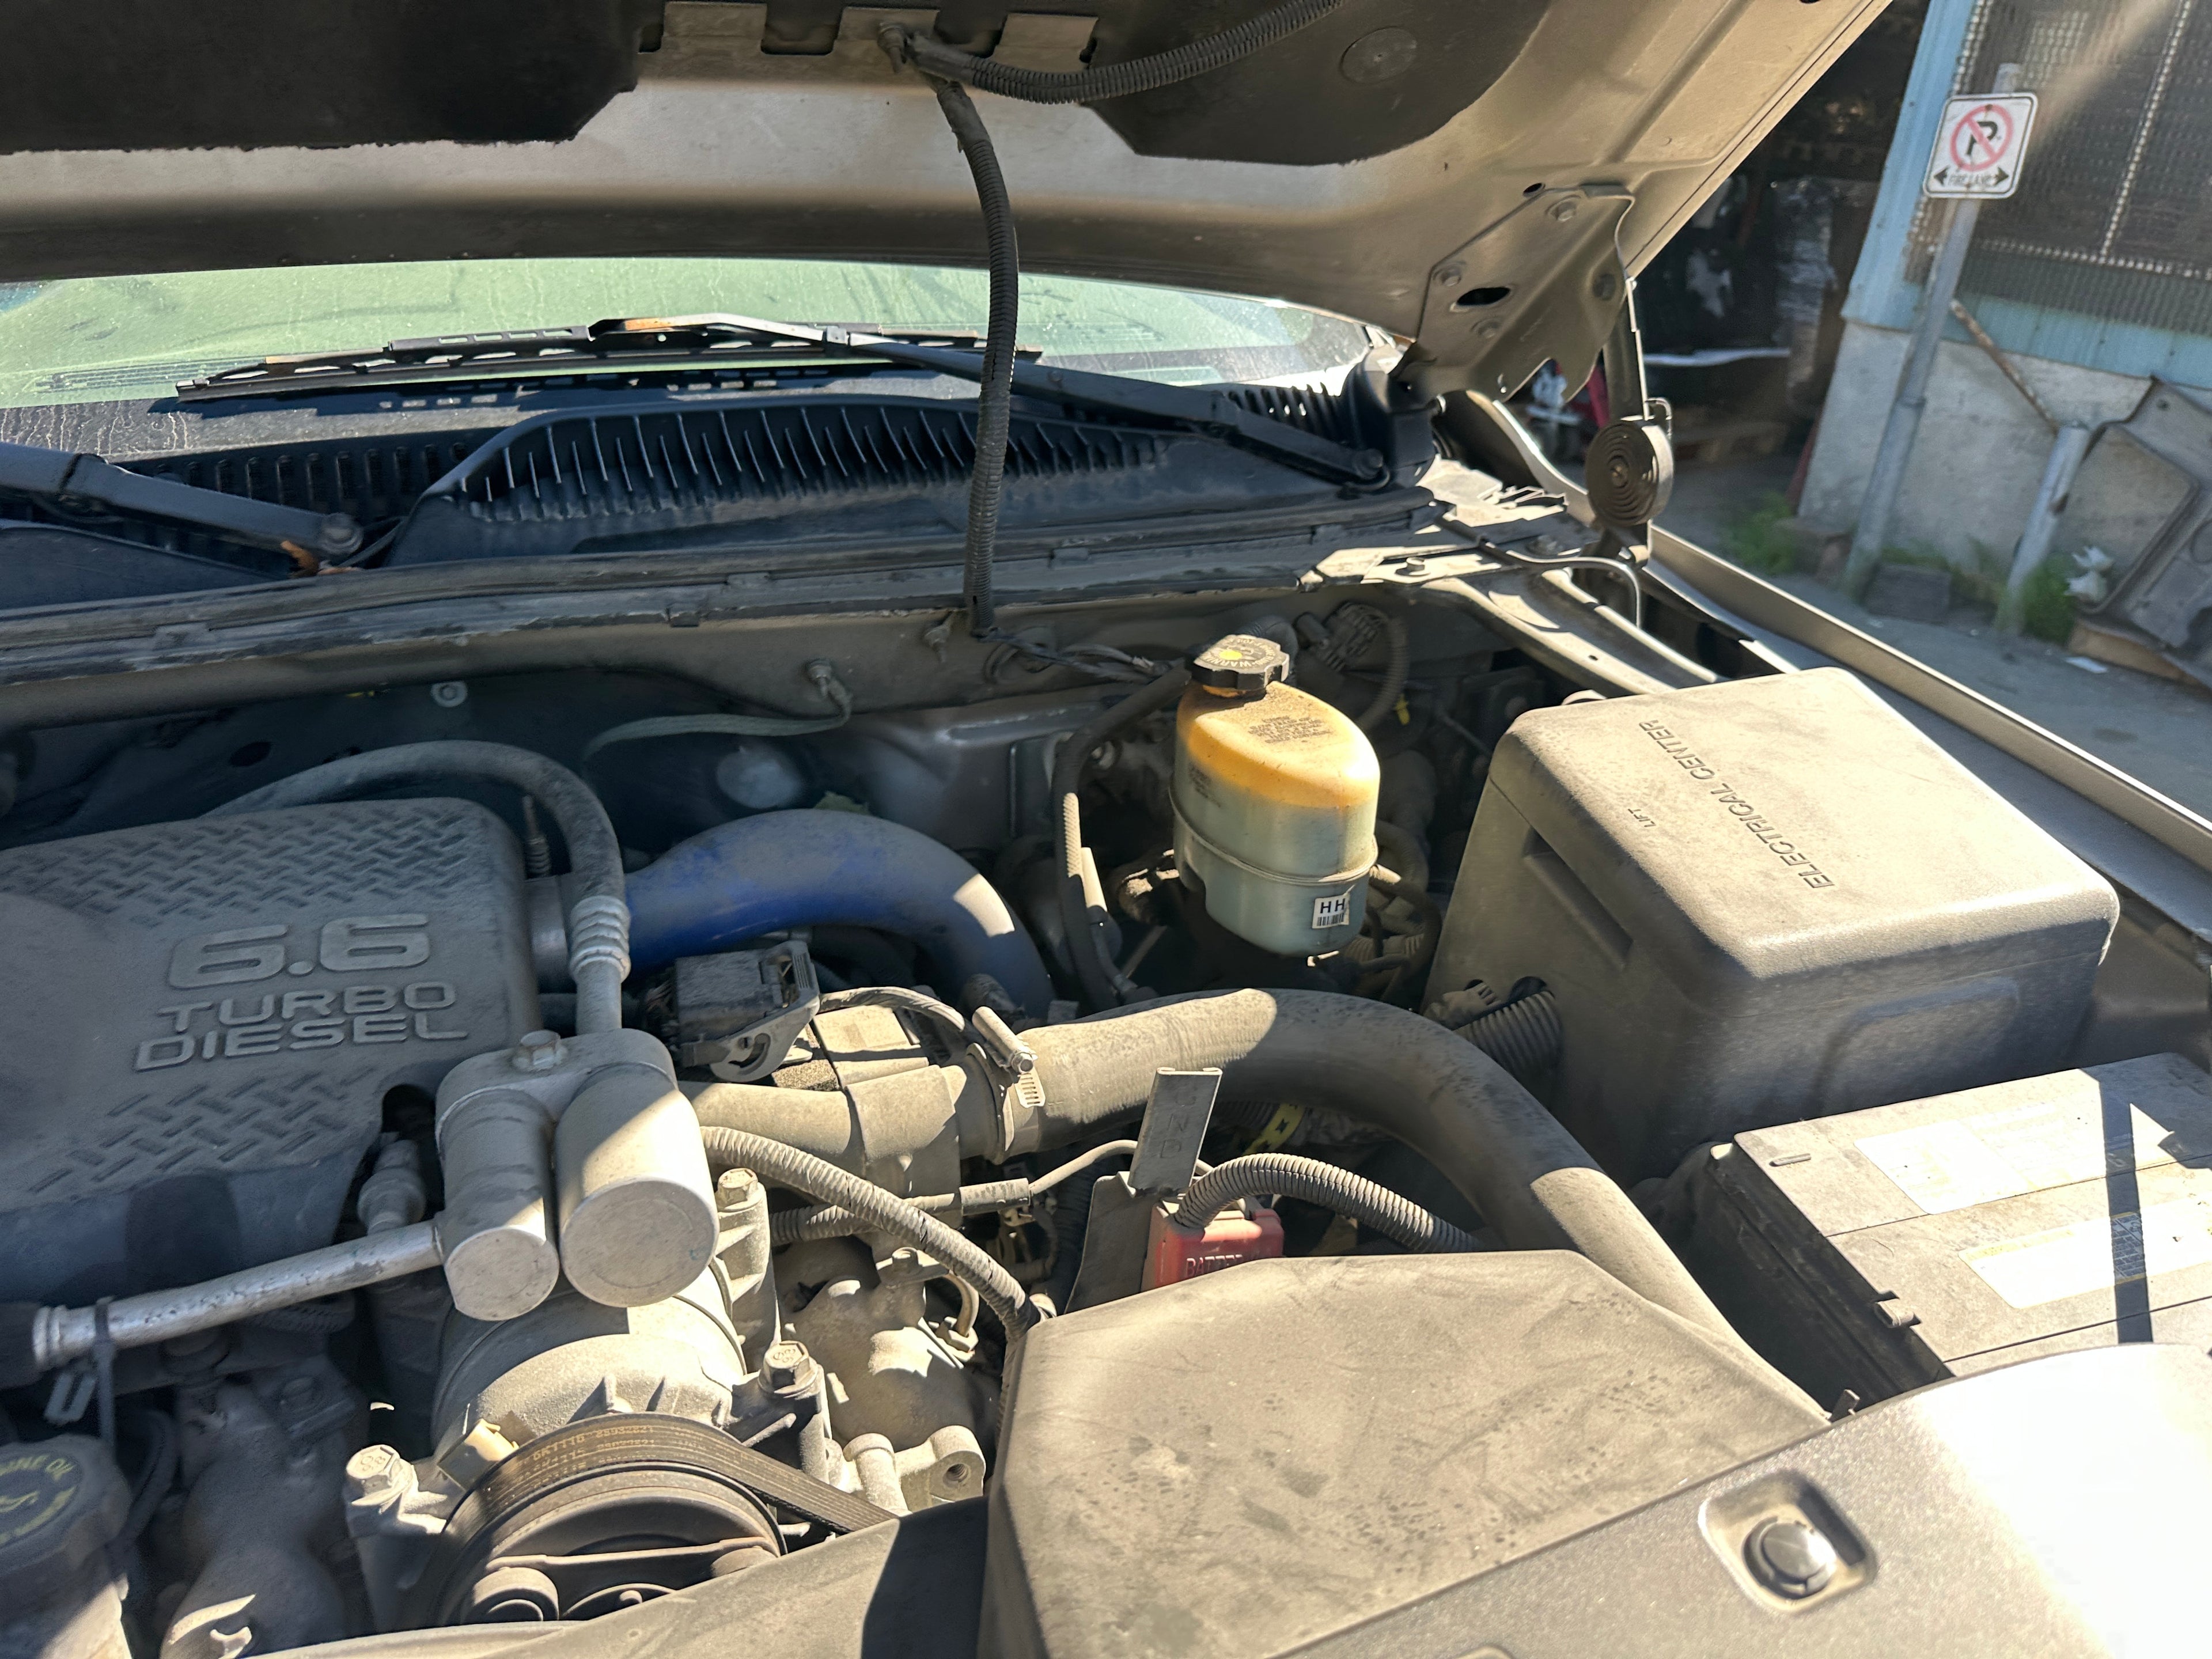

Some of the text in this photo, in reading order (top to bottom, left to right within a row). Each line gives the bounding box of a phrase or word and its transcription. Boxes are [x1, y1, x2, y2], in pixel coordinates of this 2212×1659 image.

[1627, 808, 1657, 828] LIFT
[1638, 719, 1835, 889] ELECTRICAL CENTER
[166, 912, 430, 989] 6.6
[157, 981, 457, 1033] TURBO
[132, 1012, 468, 1072] DIESEL
